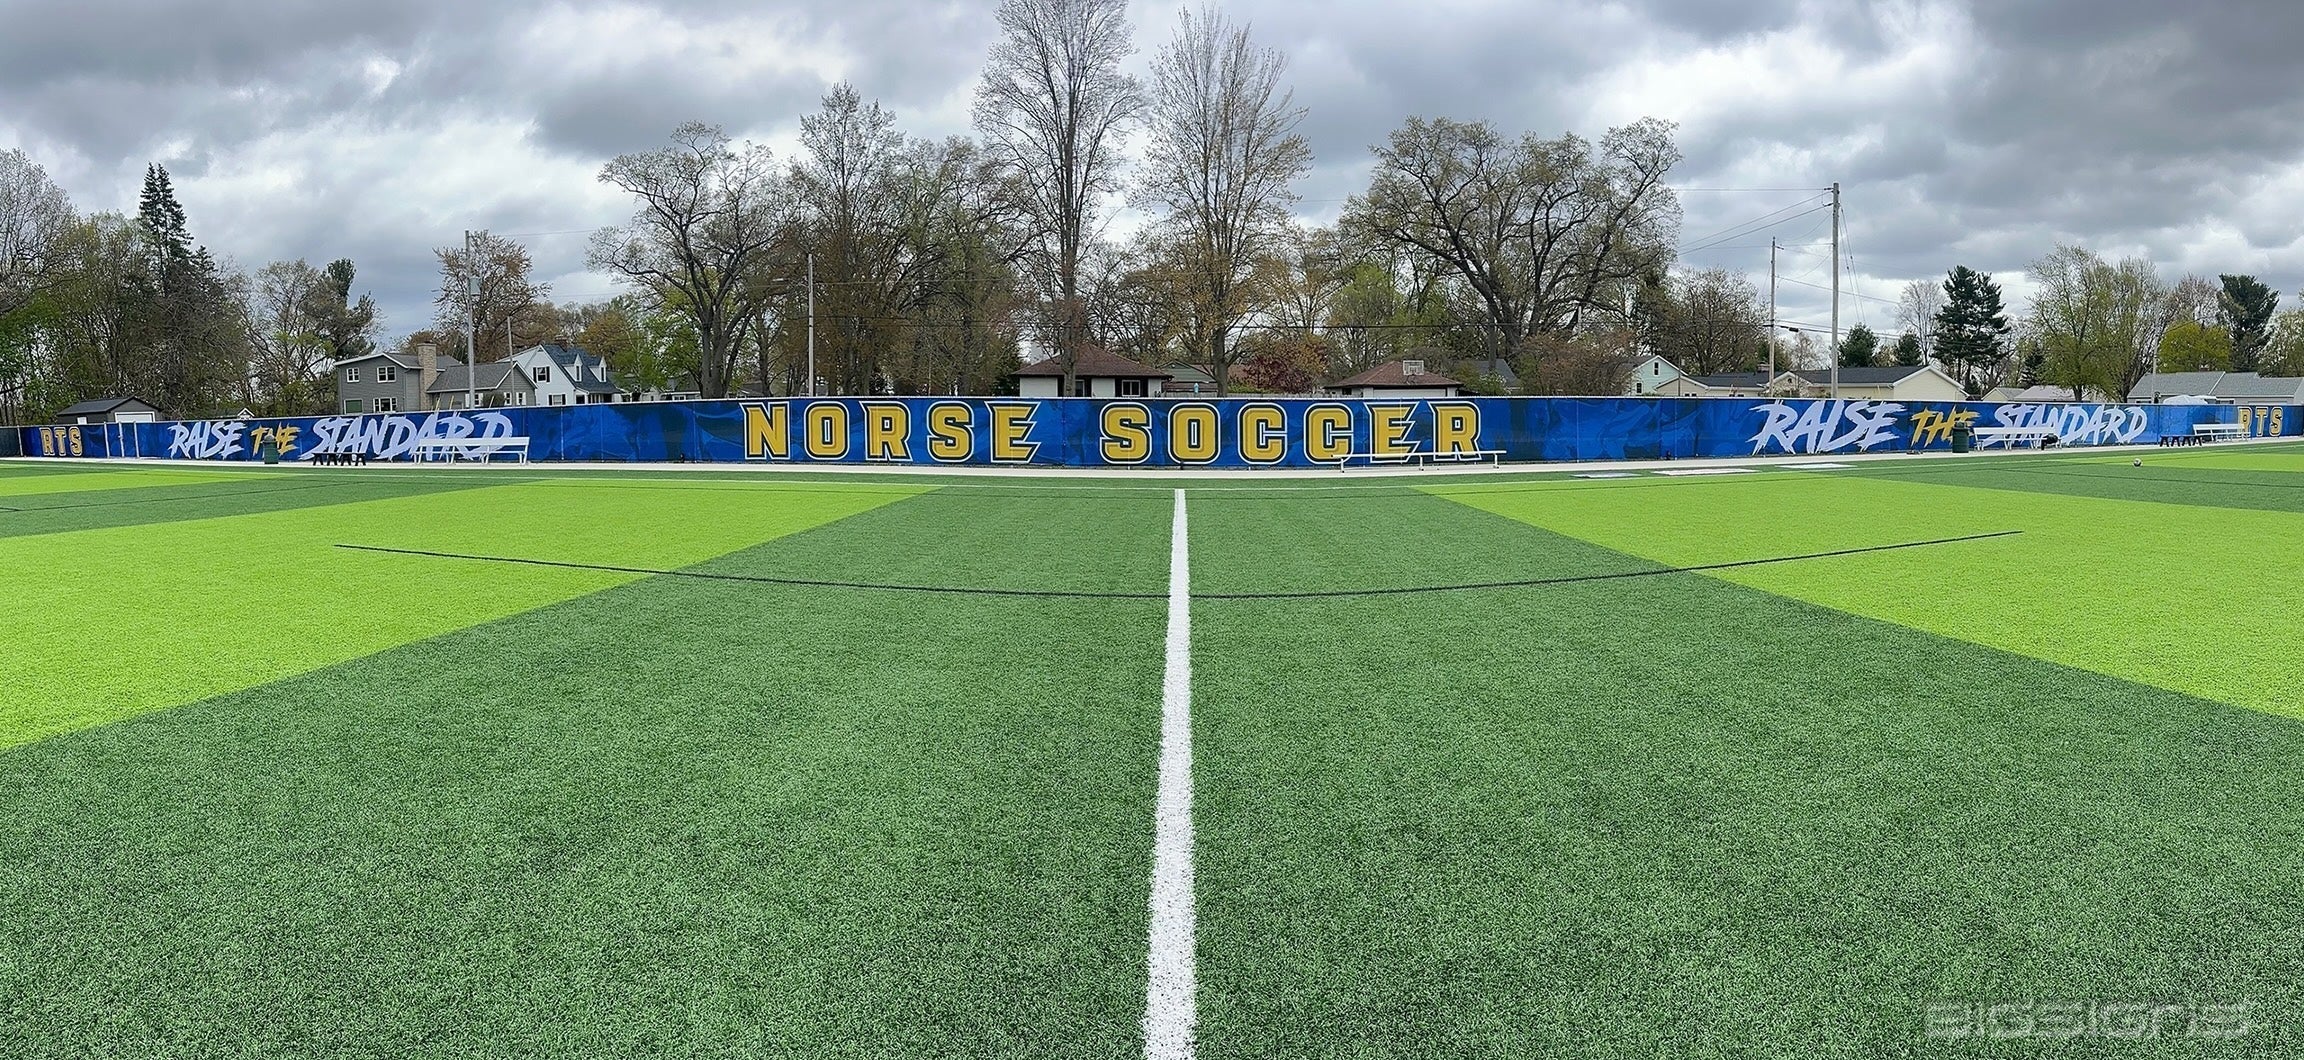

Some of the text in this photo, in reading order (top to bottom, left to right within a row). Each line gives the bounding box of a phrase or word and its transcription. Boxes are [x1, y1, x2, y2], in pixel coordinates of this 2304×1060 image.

[39, 426, 82, 456] RTS
[167, 421, 247, 460] RAISE
[299, 411, 513, 462] STANDARD
[739, 400, 1482, 465] NORSE SOCCER
[1745, 399, 1907, 455] RAISE
[1979, 402, 2148, 447] STANDARD
[2236, 405, 2284, 438] RTS
